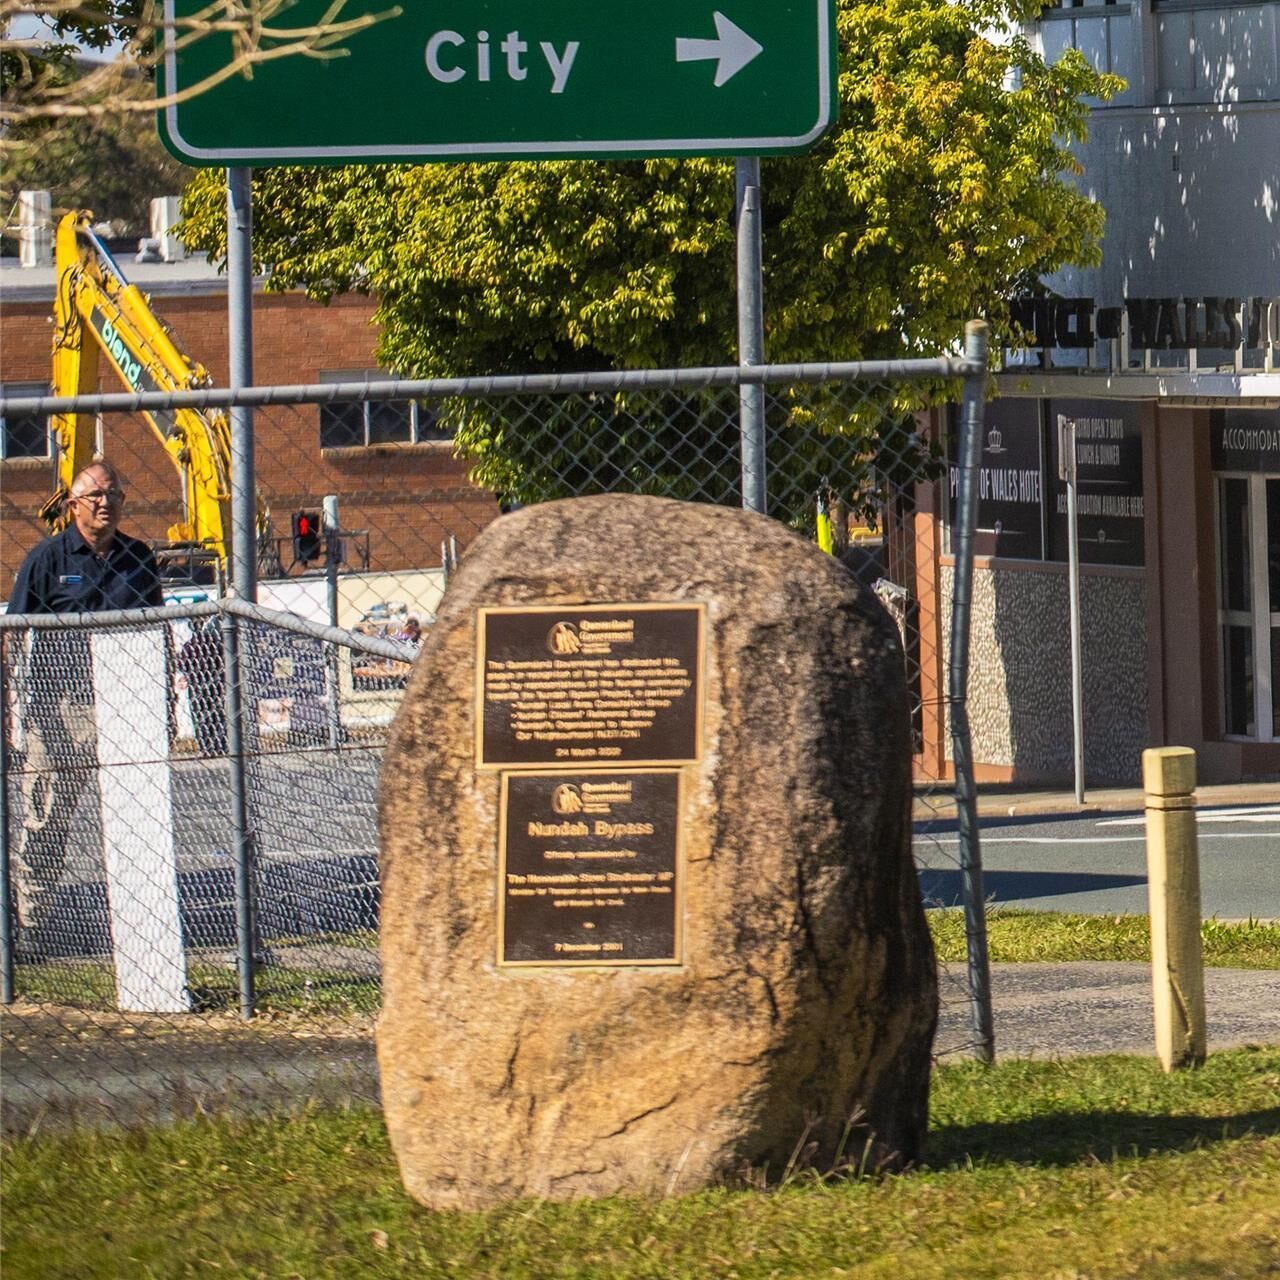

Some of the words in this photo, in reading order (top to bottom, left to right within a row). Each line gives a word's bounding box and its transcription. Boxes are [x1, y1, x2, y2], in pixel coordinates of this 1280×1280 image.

[425, 30, 580, 94] City
[980, 467, 990, 500] OF
[991, 468, 1018, 502] WALES
[528, 822, 588, 836] Nundah
[595, 821, 654, 838] Bypass
